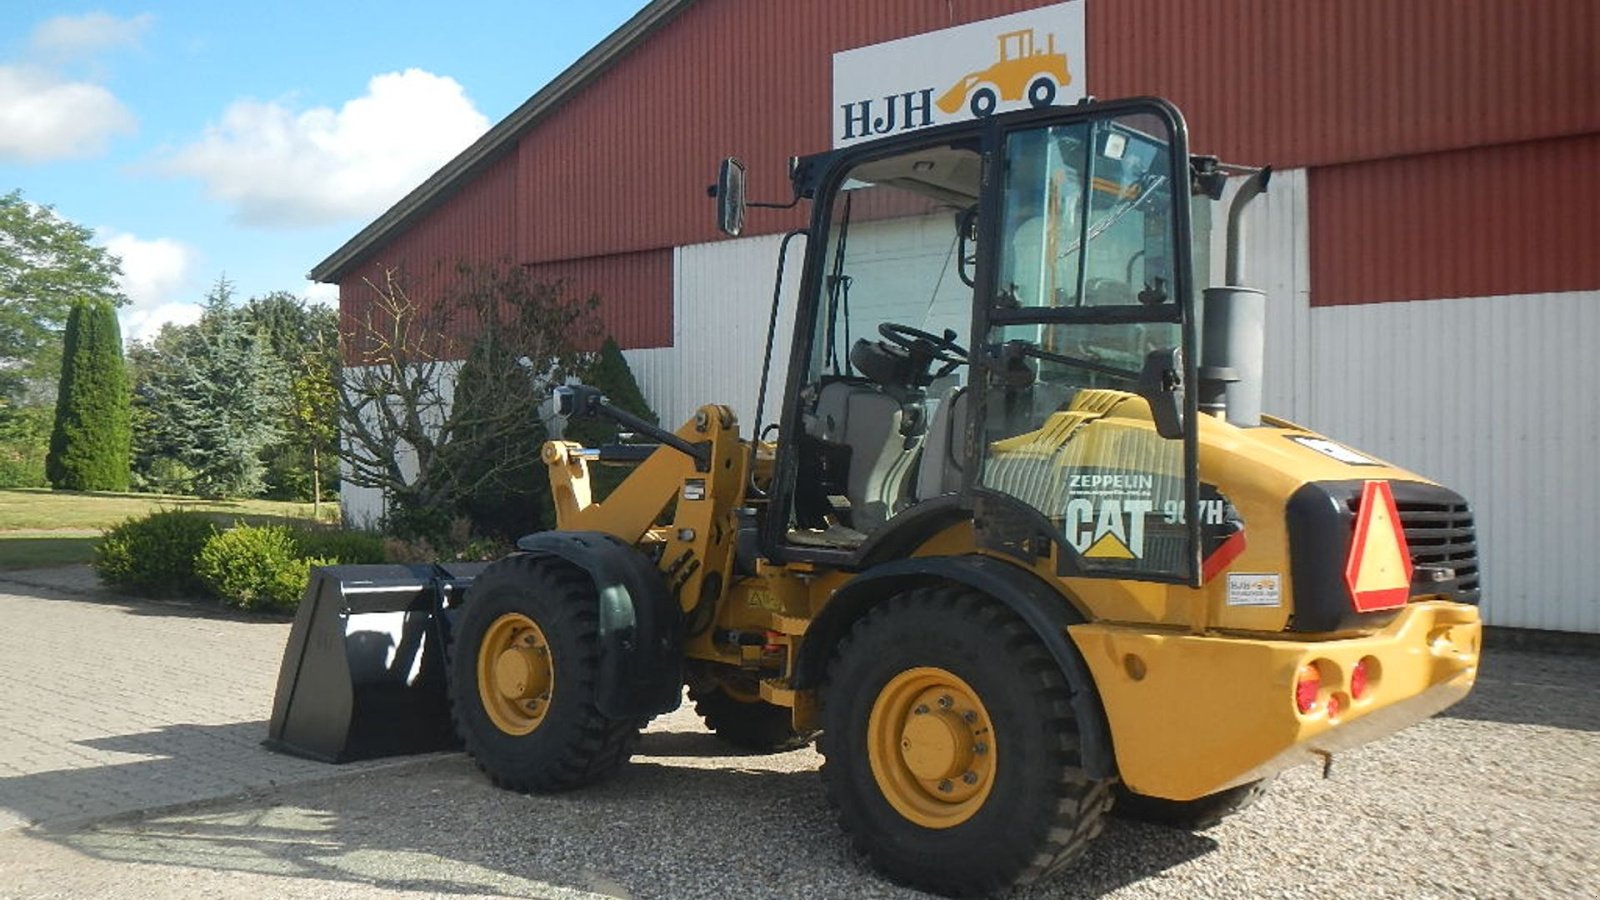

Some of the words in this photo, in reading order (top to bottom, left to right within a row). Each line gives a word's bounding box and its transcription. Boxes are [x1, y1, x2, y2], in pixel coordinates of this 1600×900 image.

[841, 87, 935, 141] HJH
[1069, 474, 1153, 489] ZEPPELIN
[1066, 499, 1153, 559] CAT
